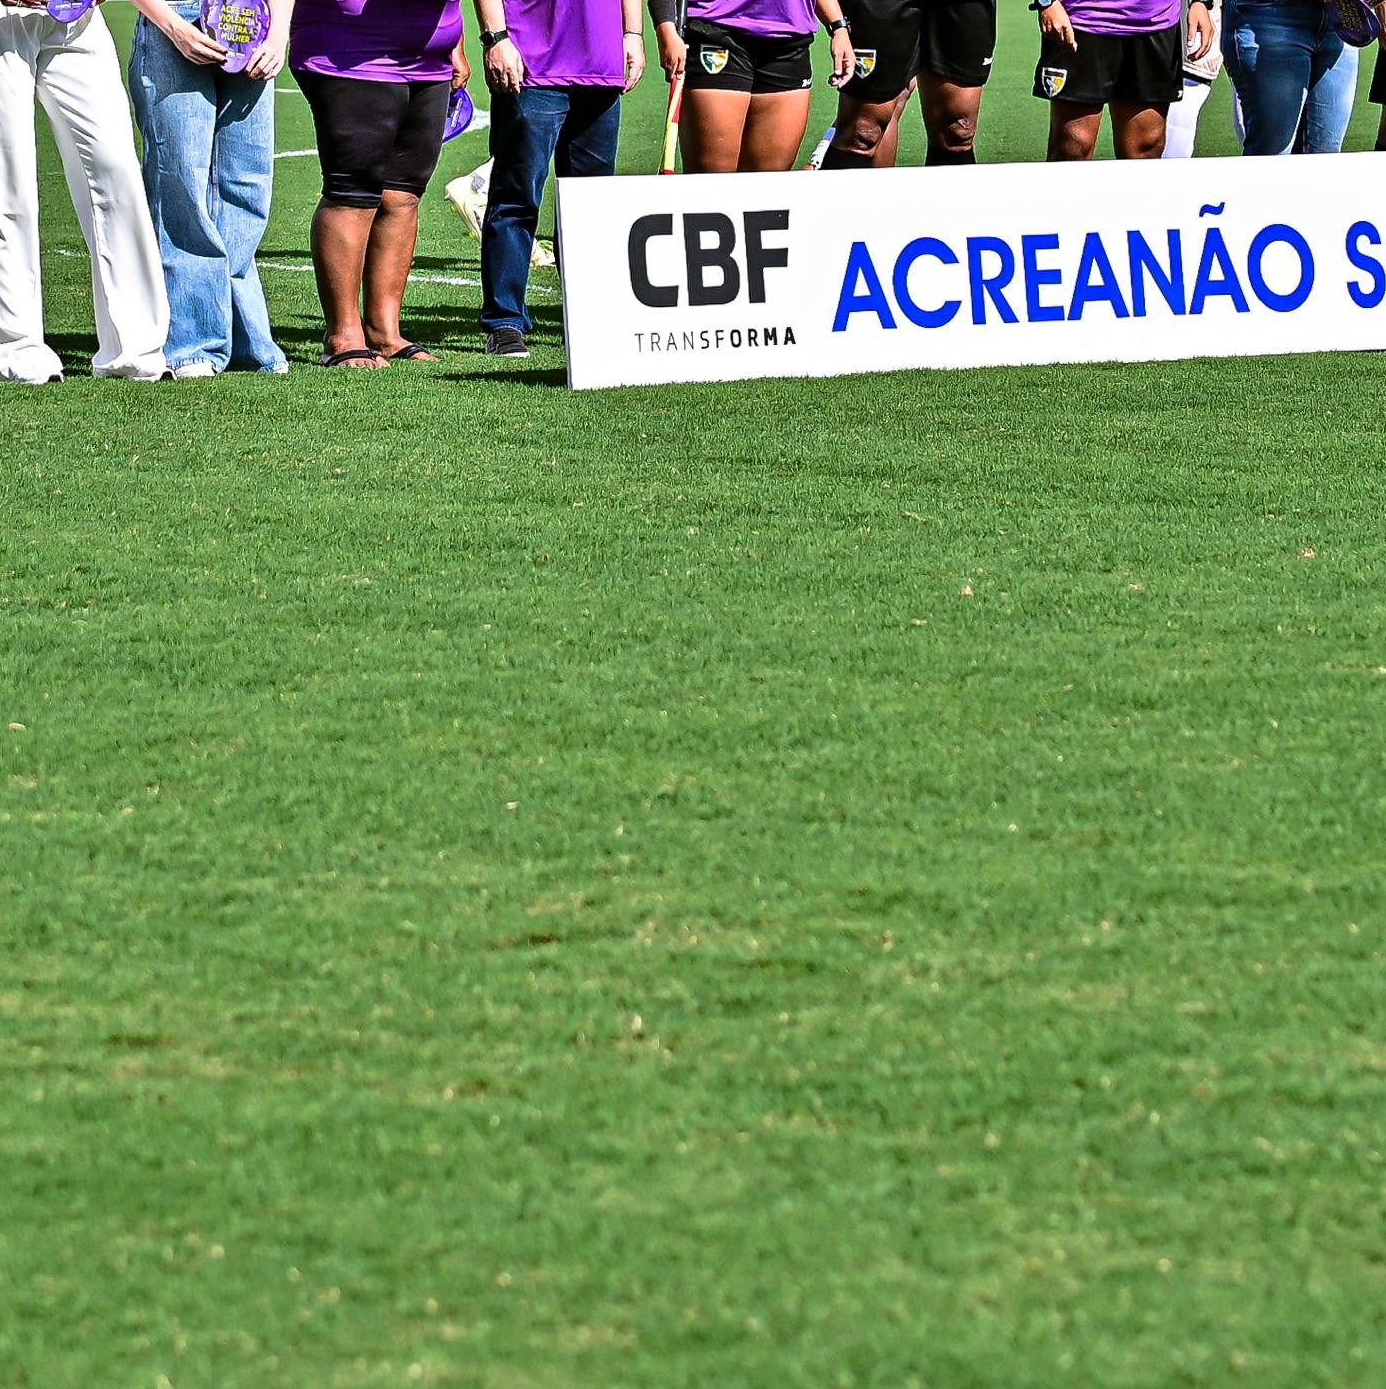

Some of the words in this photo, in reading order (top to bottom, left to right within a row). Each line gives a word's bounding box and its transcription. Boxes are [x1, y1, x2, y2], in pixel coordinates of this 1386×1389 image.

[628, 209, 791, 308] CBF
[832, 202, 1316, 333] ACREANÃO
[634, 327, 797, 353] TRANSFORMA
